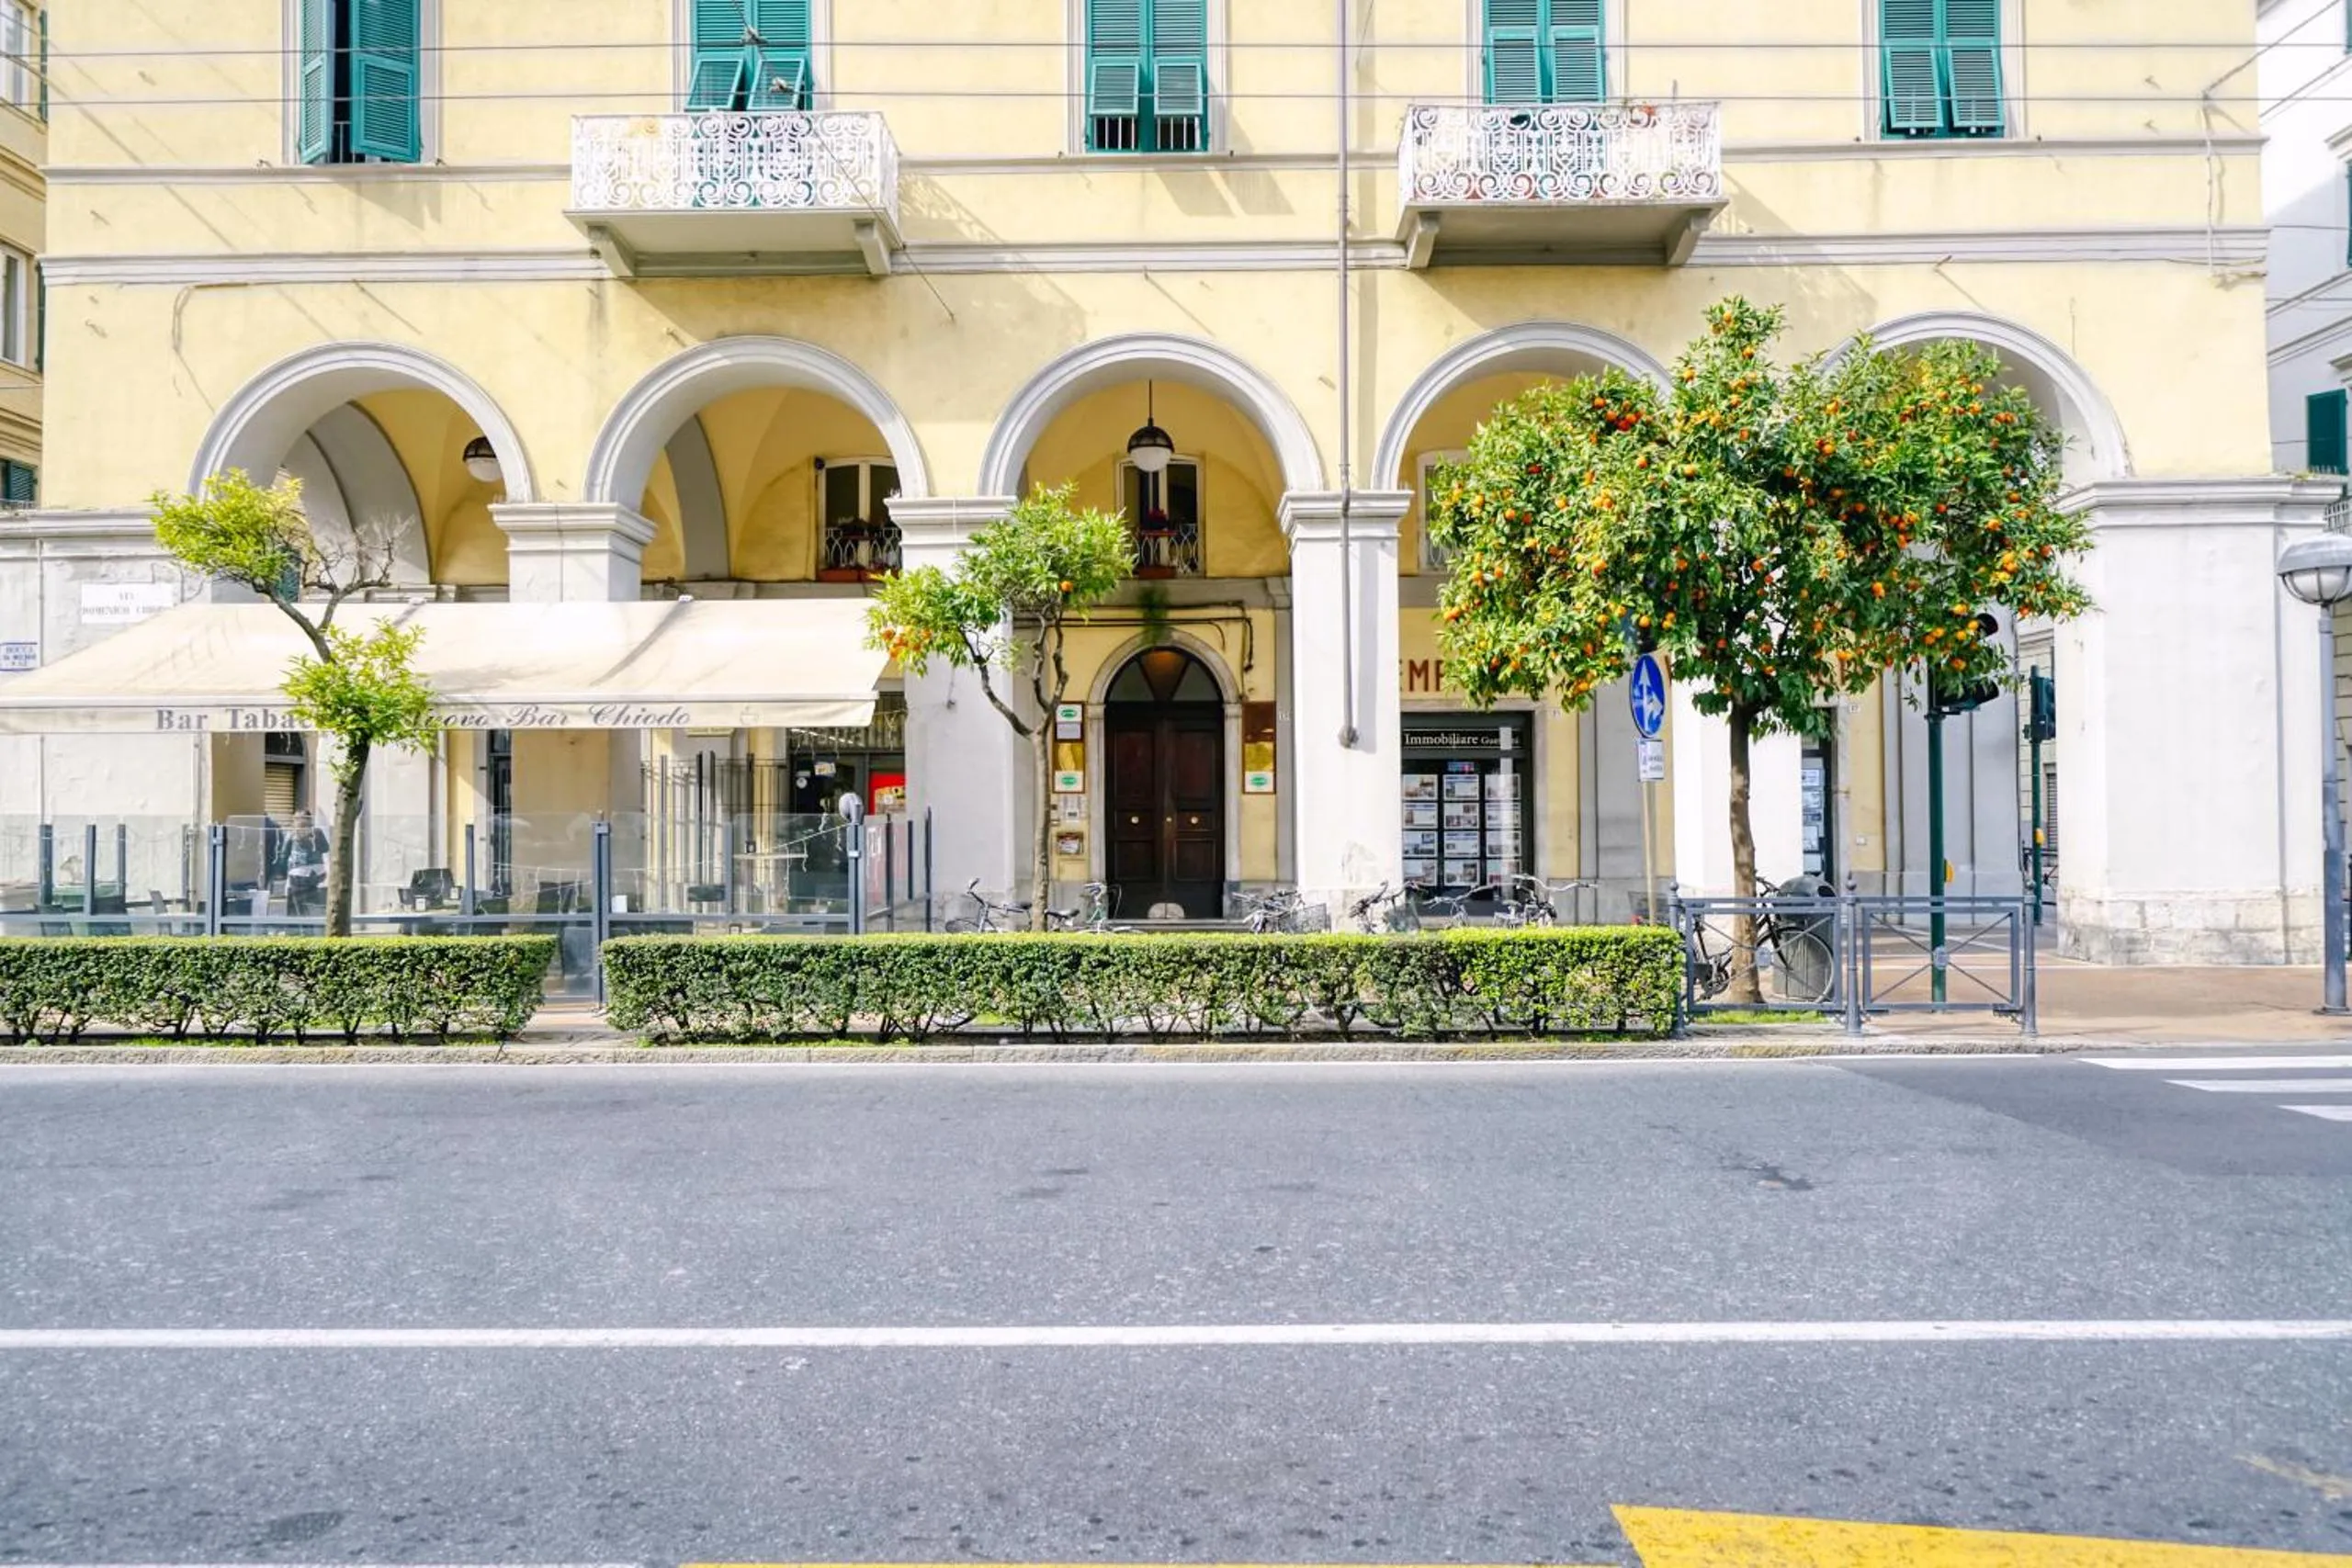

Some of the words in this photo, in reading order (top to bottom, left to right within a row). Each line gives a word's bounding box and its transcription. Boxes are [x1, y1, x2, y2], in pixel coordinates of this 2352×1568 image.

[155, 709, 209, 730] Bar
[225, 708, 312, 730] Tabac
[506, 705, 570, 727] Bar
[588, 705, 691, 727] Chiodo
[1405, 732, 1478, 746] Immobiliare
